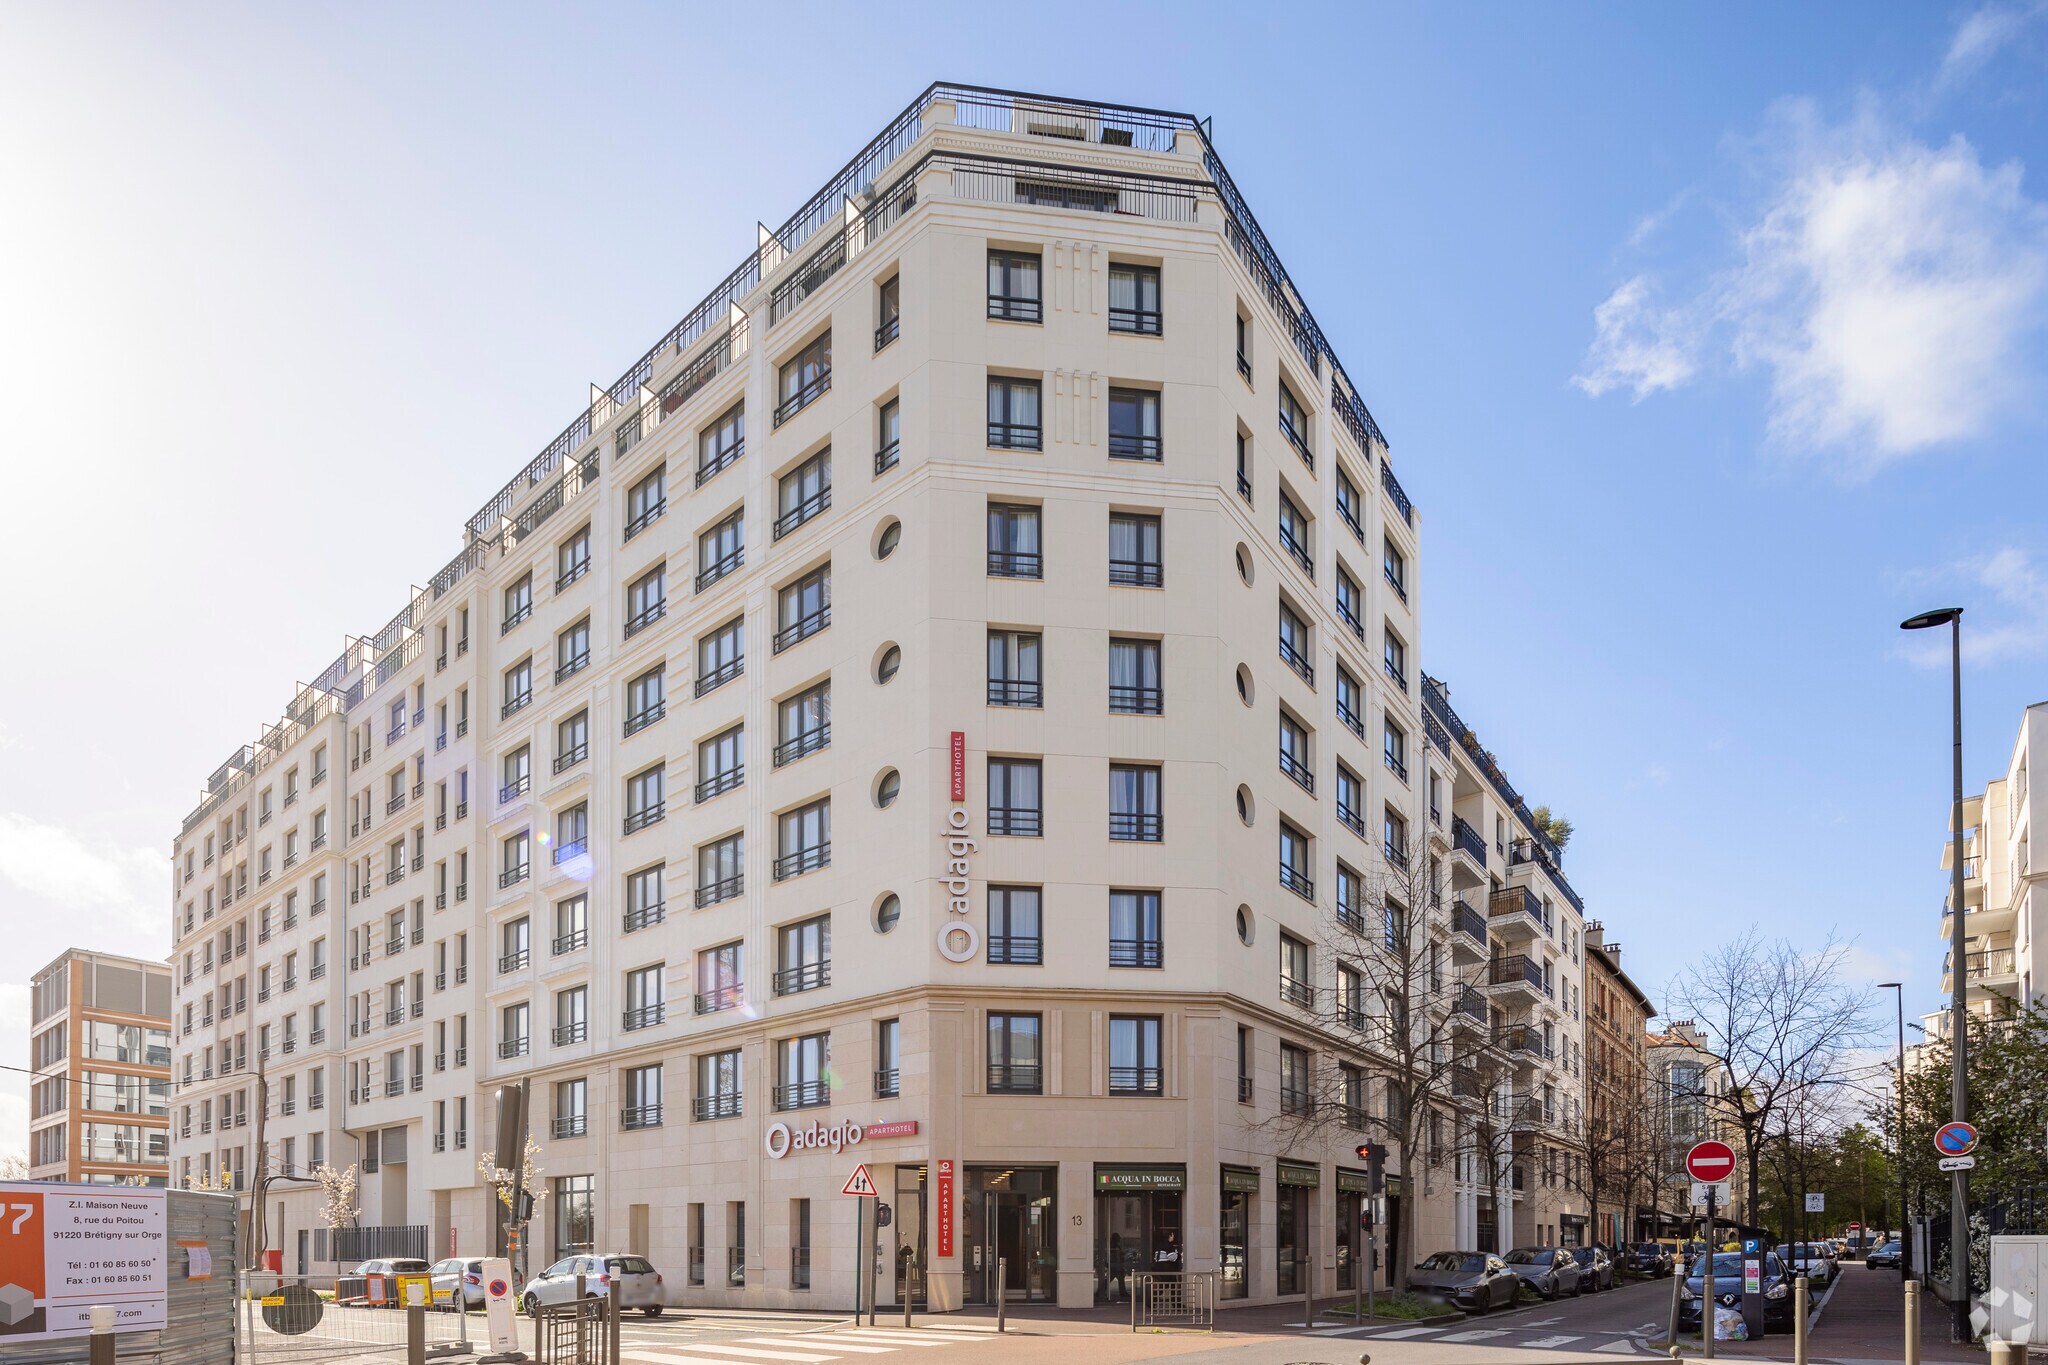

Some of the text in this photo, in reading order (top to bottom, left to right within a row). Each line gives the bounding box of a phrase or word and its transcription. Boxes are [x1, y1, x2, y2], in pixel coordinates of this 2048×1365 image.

[954, 735, 962, 795] APARTHOTEL
[938, 807, 978, 914] adagio
[793, 1119, 863, 1154] adagio
[869, 1127, 912, 1135] APARTHOTEL
[1111, 1175, 1139, 1184] ACQUA
[69, 1201, 148, 1210] Z.I. Maison Neuve
[74, 1217, 82, 1225] 8,
[116, 1216, 144, 1224] Poitou
[1072, 1215, 1082, 1226] 13
[84, 1231, 123, 1240] Brétigny
[141, 1231, 162, 1240] Orge
[1746, 1240, 1754, 1251] P
[67, 1261, 82, 1269] Tél
[66, 1277, 83, 1285] Fax
